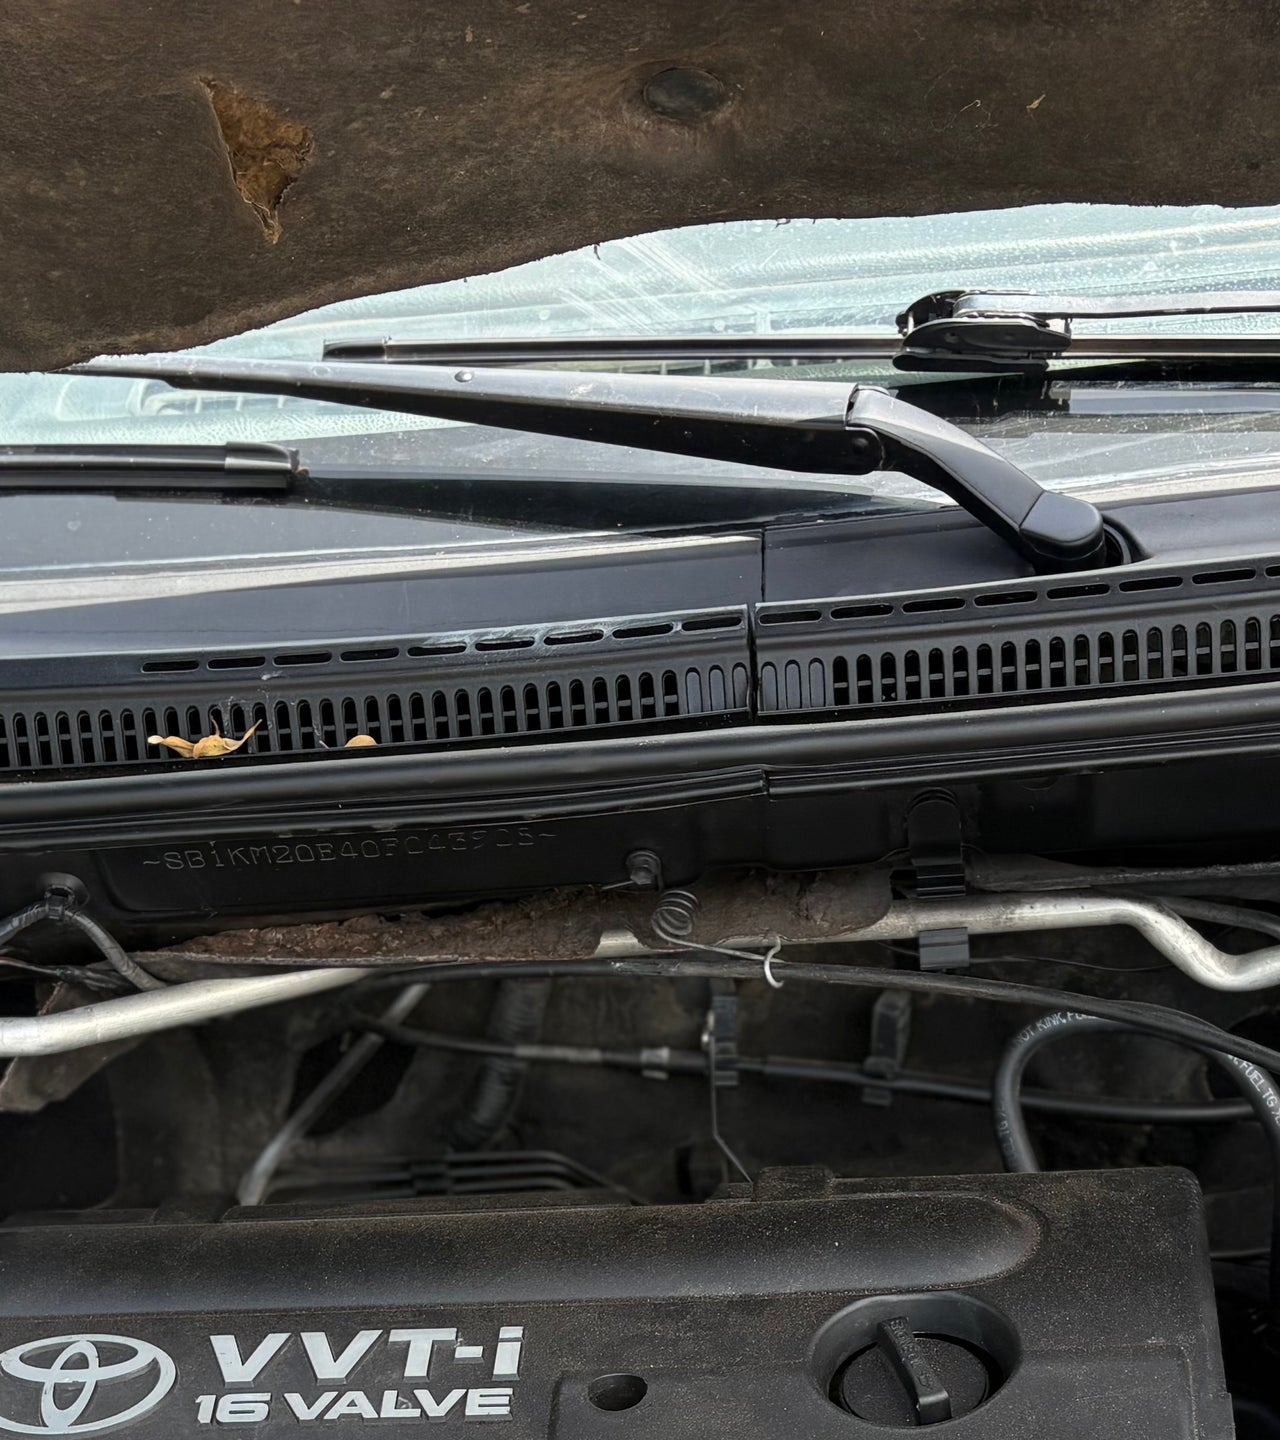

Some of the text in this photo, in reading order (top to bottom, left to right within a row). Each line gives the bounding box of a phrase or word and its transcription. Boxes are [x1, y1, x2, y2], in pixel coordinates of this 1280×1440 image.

[1240, 1060, 1265, 1092] FUEL
[1262, 1088, 1278, 1108] TG
[208, 1325, 524, 1385] VVT-i
[196, 1388, 514, 1424] 16 VALVE
